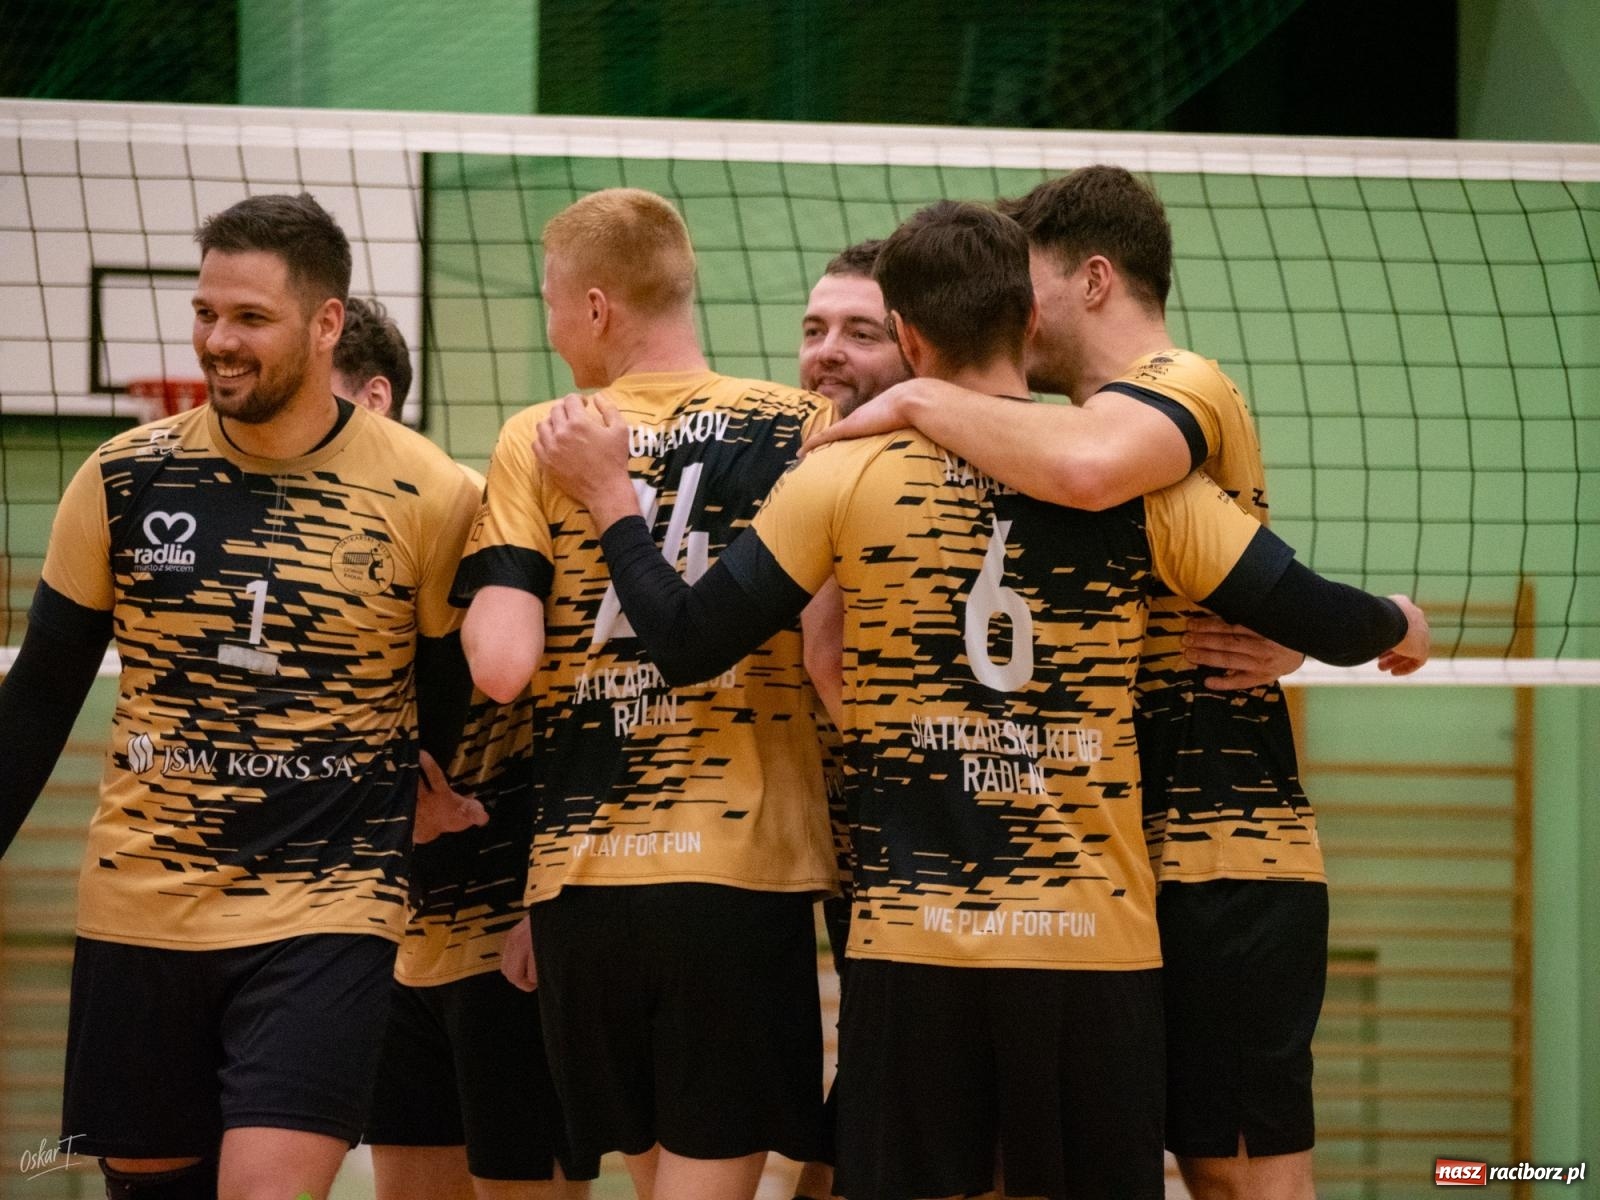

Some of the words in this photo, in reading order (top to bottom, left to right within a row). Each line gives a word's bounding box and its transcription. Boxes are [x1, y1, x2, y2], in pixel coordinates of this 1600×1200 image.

[627, 410, 731, 458] UMAKOV
[134, 543, 196, 565] radlin
[246, 580, 268, 644] 1
[964, 513, 1035, 692] 6
[228, 751, 311, 780] KOKS
[320, 755, 353, 779] SA
[624, 832, 657, 857] FOR
[663, 831, 701, 854] FUN
[923, 906, 955, 933] WE
[958, 910, 1006, 937] PLAY
[1011, 911, 1053, 937] FOR
[1058, 912, 1096, 938] FUN
